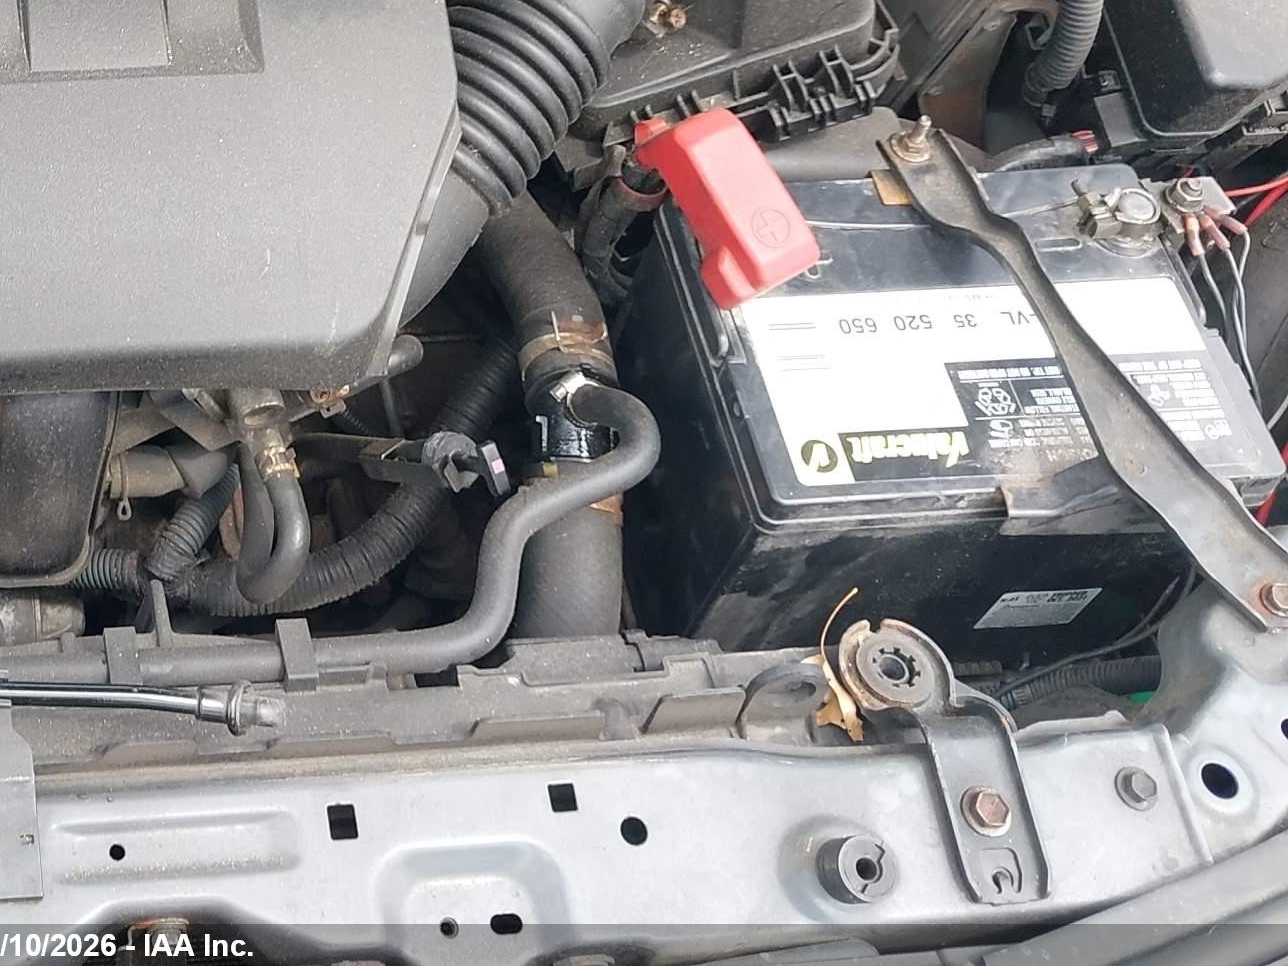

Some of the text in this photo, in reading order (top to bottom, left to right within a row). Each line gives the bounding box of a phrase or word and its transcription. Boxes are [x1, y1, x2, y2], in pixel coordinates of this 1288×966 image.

[839, 317, 877, 334] 650
[893, 314, 933, 331] 520
[953, 313, 978, 328] 35
